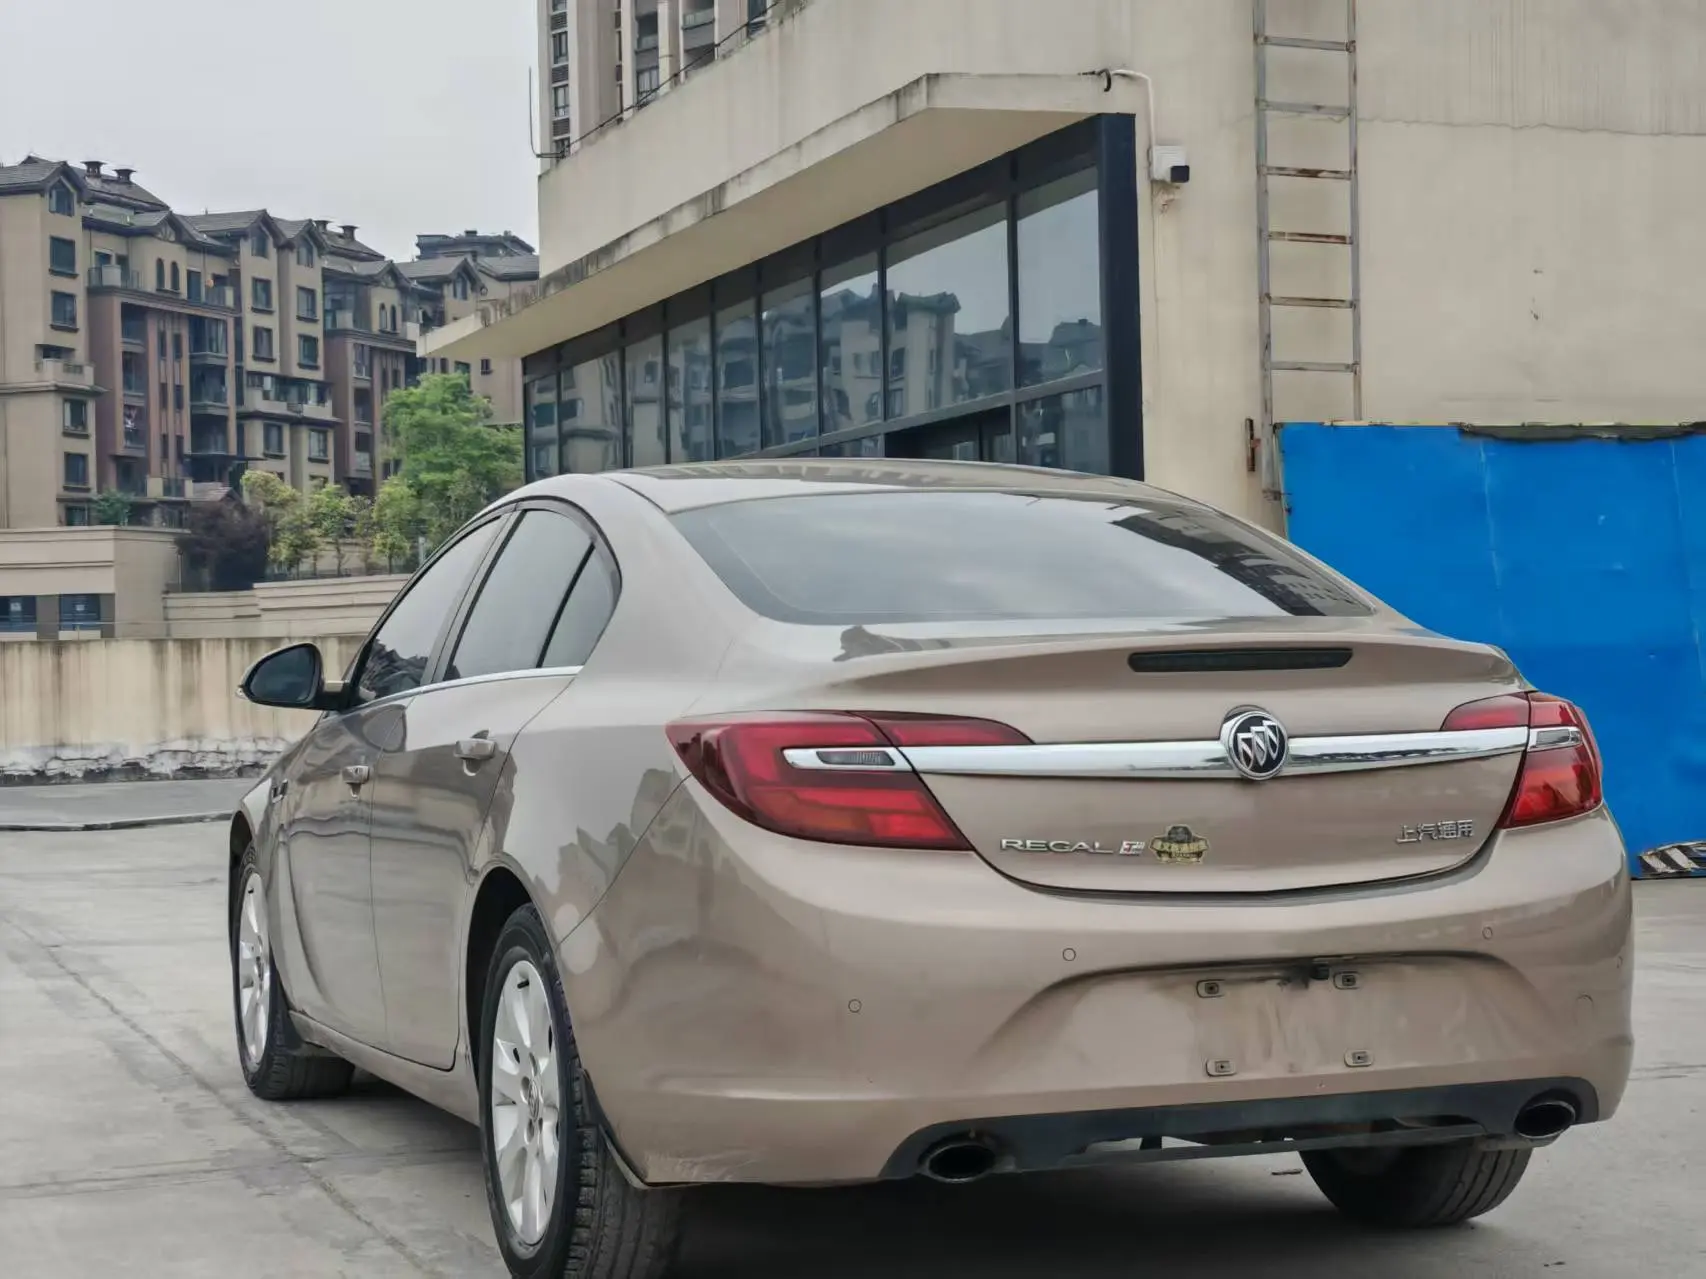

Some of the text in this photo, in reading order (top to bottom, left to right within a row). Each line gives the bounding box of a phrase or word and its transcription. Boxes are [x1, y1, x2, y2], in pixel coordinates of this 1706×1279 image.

[1396, 819, 1474, 844] 上汽通用
[1000, 838, 1114, 855] REGAL
